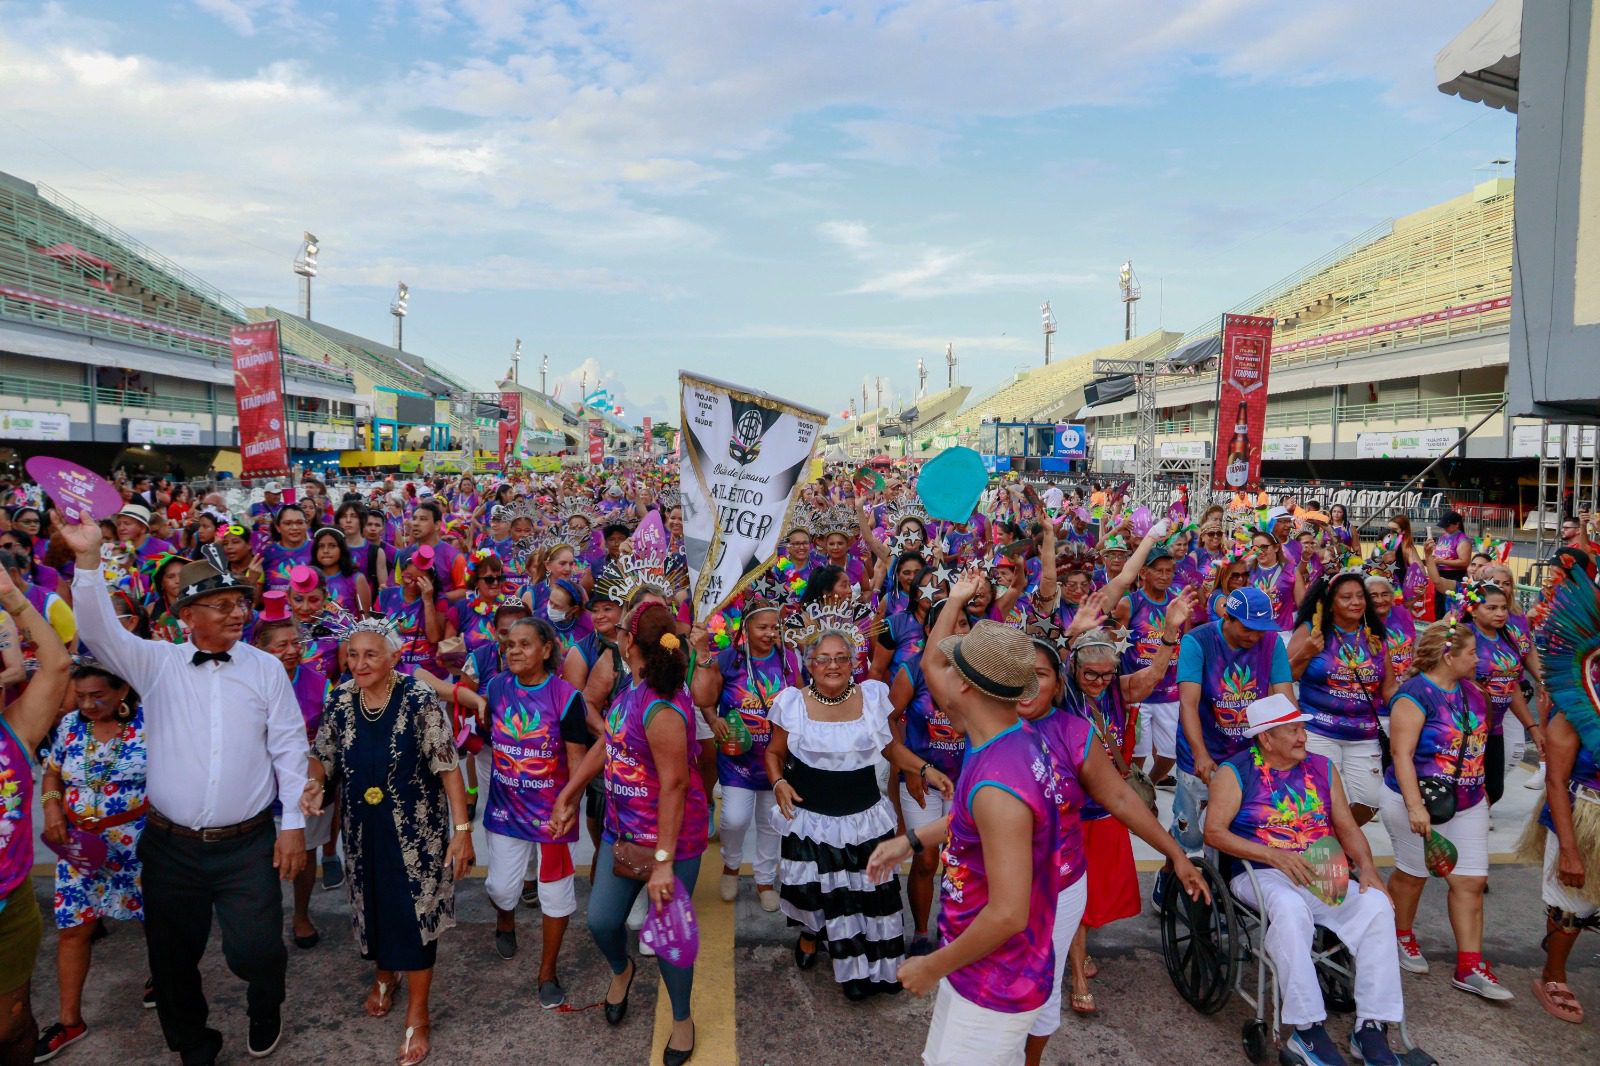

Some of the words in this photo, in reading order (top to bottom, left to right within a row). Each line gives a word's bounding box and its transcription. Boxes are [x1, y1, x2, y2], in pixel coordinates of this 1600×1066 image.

[237, 351, 274, 369] ITAIPAVA
[240, 390, 277, 410] ITAIPAVA
[245, 437, 281, 458] ITAIPAVA
[711, 483, 763, 506] ATLÉTICO
[620, 550, 661, 574] Baile
[608, 576, 634, 607] Rio
[806, 598, 853, 620] Baile
[784, 624, 816, 649] Rio
[1141, 637, 1161, 645] GRANDE
[1136, 657, 1153, 666] PESS
[928, 741, 957, 751] PESSOAS
[522, 778, 555, 789] IDOSAS
[613, 783, 648, 798] IDOSAS
